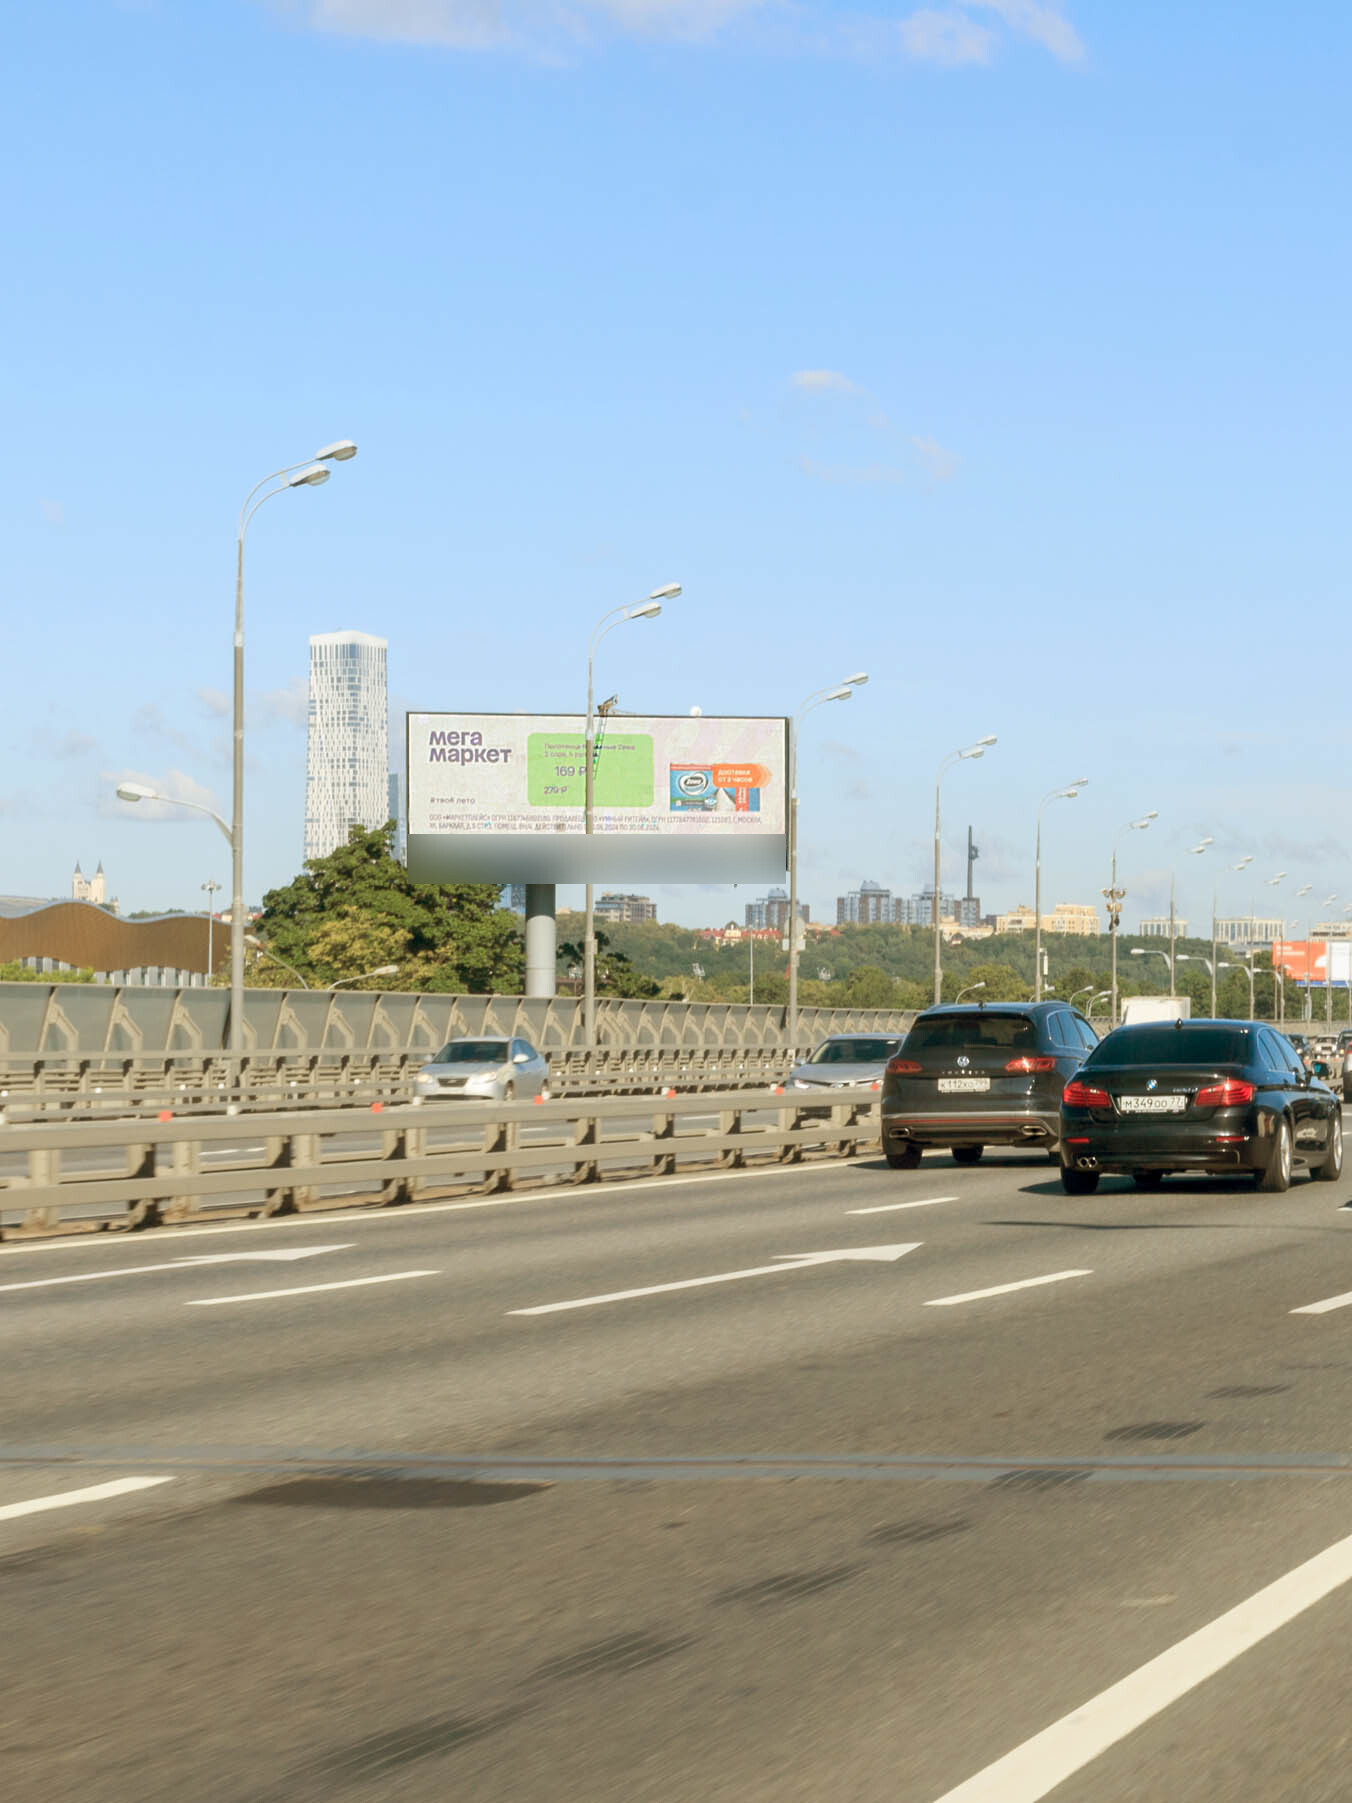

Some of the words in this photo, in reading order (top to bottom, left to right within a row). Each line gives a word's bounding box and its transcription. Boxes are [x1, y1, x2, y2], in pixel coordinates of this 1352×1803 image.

[429, 731, 482, 746] мега
[429, 748, 512, 766] маркет
[555, 766, 575, 777] 169
